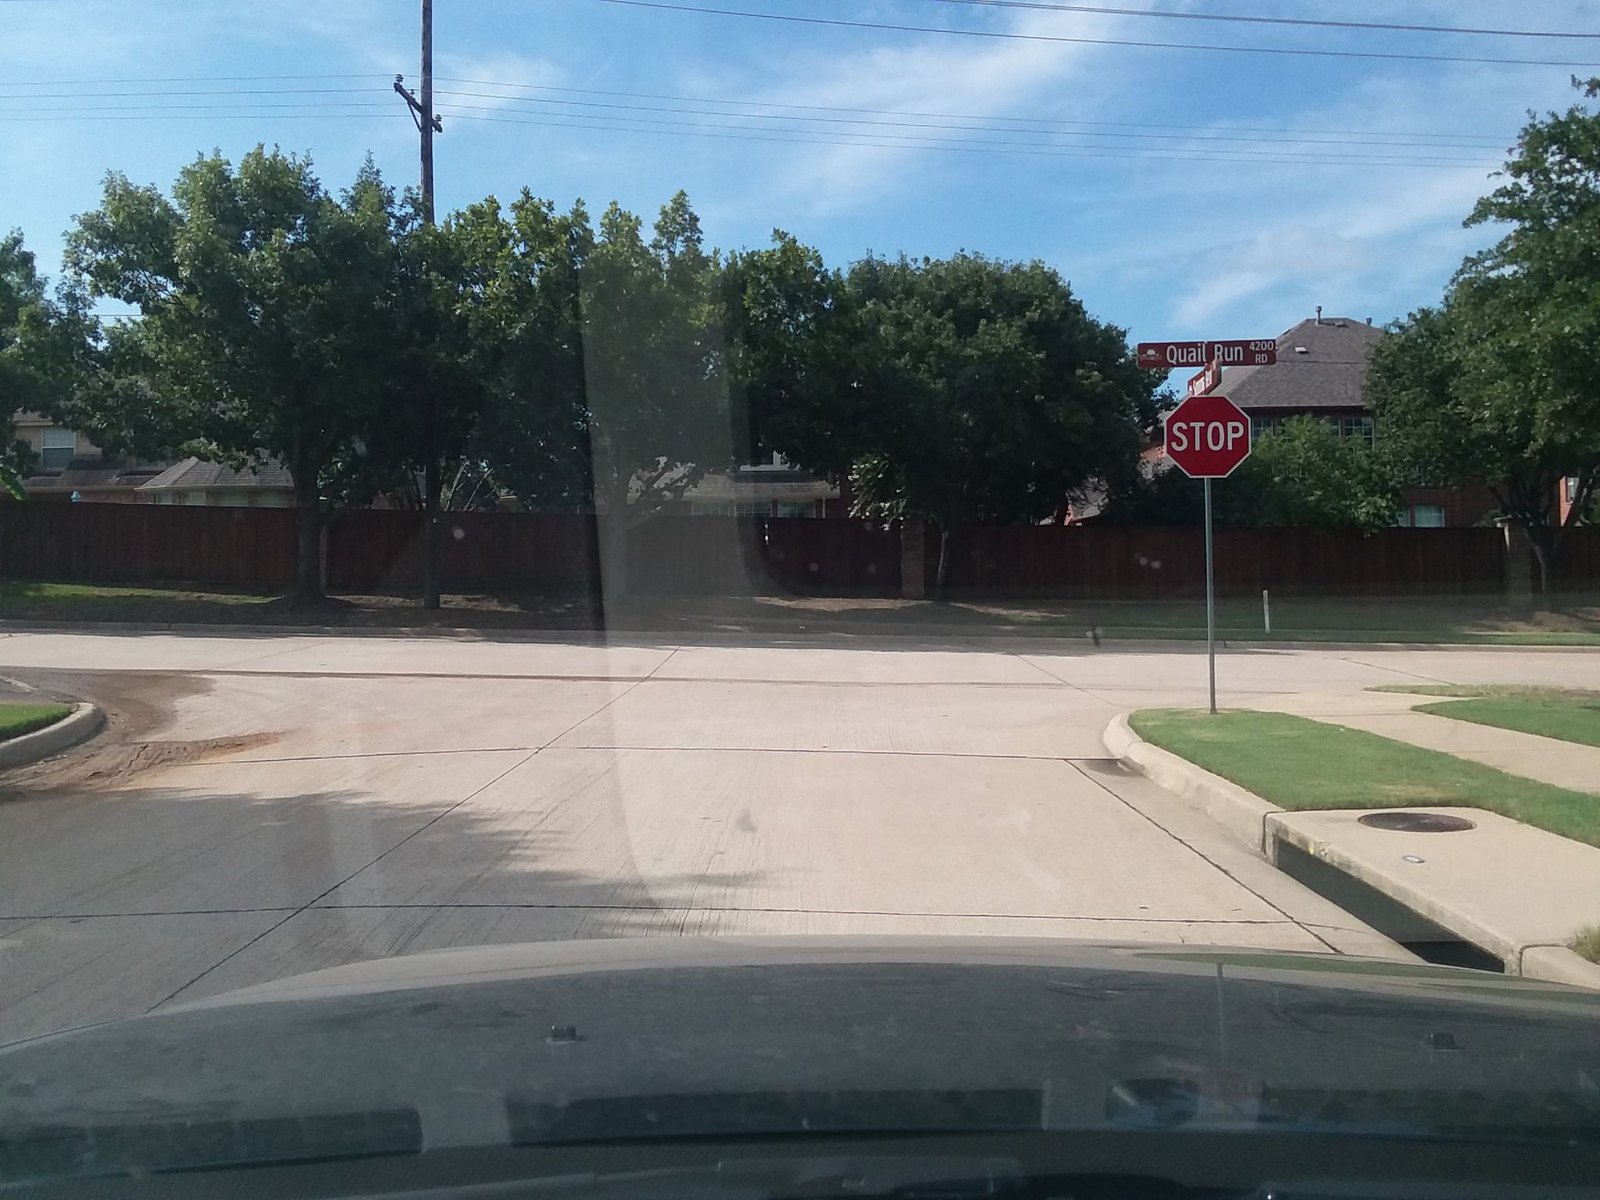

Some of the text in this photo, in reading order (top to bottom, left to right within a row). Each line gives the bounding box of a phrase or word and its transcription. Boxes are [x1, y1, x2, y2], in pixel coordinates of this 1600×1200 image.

[1166, 343, 1244, 364] Quail Run
[1249, 341, 1274, 351] 4200
[1255, 354, 1268, 363] RD
[1171, 421, 1244, 451] STOP
